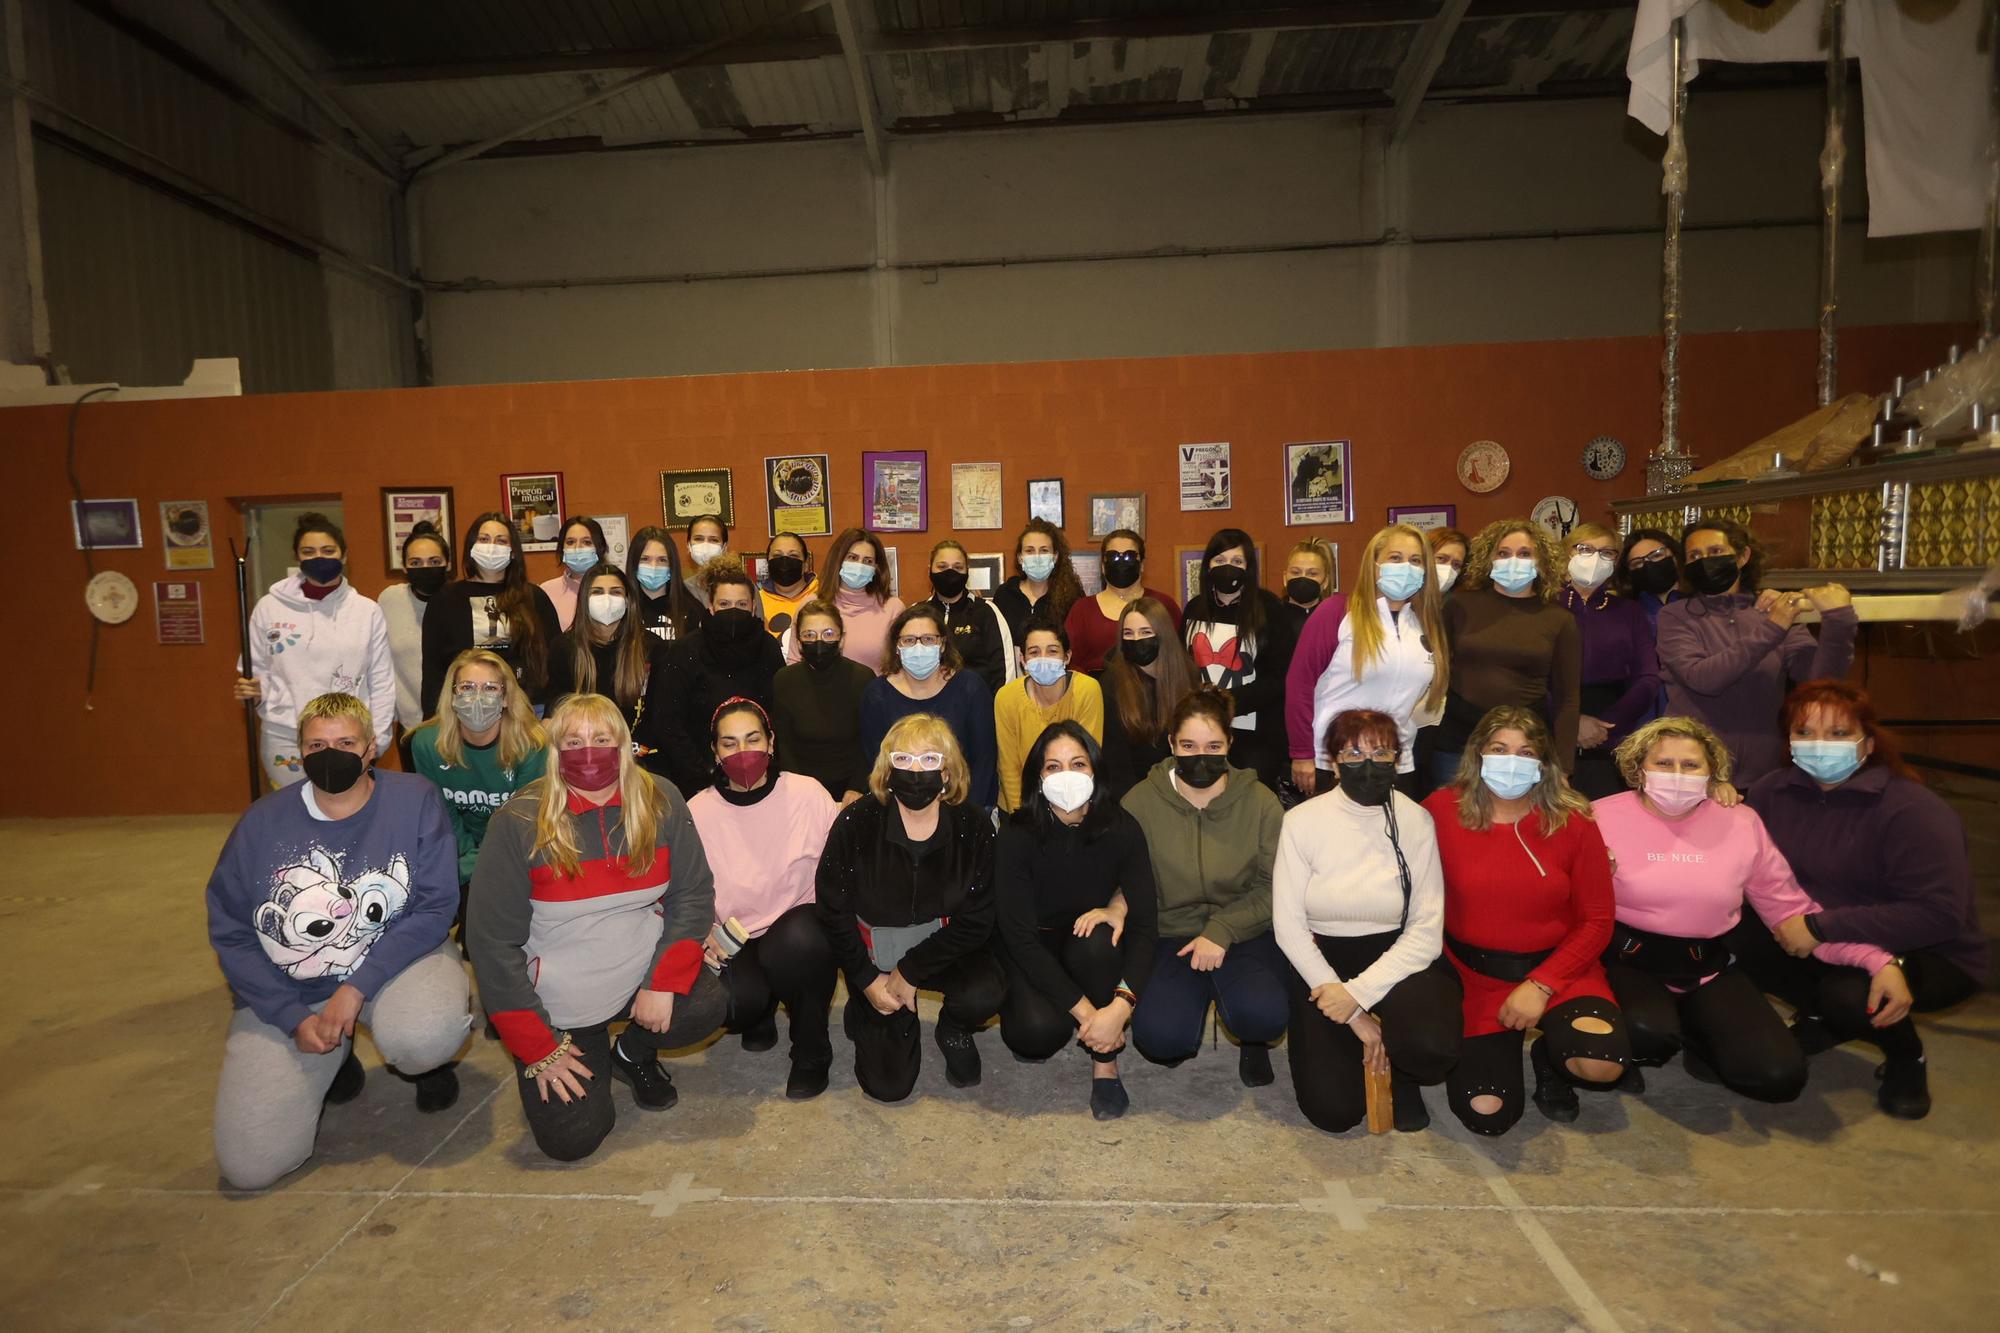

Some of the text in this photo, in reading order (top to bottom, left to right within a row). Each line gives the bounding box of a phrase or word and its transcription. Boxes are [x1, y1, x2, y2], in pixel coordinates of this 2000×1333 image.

[1182, 447, 1195, 462] V
[511, 486, 543, 497] Pregón
[521, 491, 555, 502] musical
[1647, 852, 1665, 862] BE
